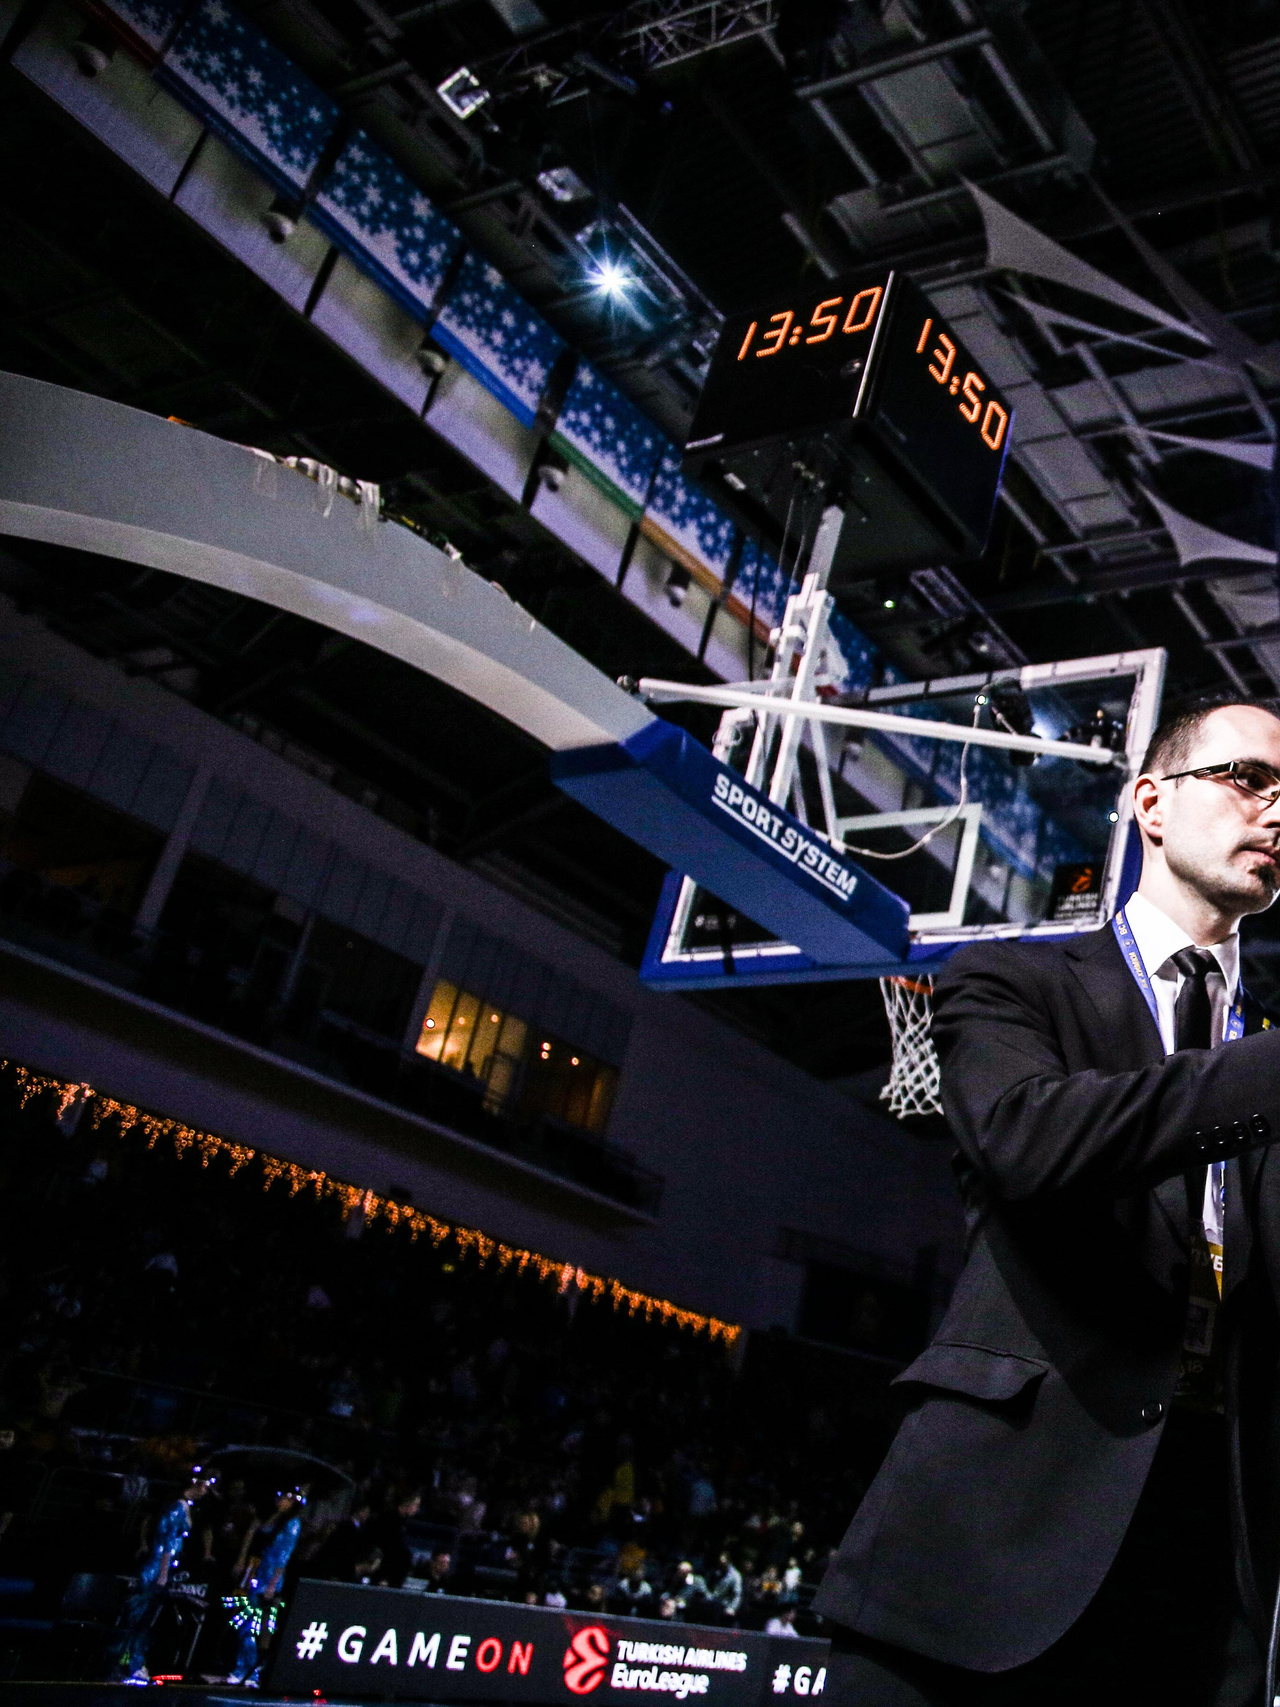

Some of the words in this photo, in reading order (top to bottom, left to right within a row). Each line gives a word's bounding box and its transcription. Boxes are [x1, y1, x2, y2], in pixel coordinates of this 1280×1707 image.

[737, 286, 882, 360] 13:50
[916, 318, 1007, 450] 13:50
[610, 1662, 709, 1699] EuroLeague
[617, 1640, 685, 1666] TURKISH
[684, 1647, 748, 1672] AIRLINES
